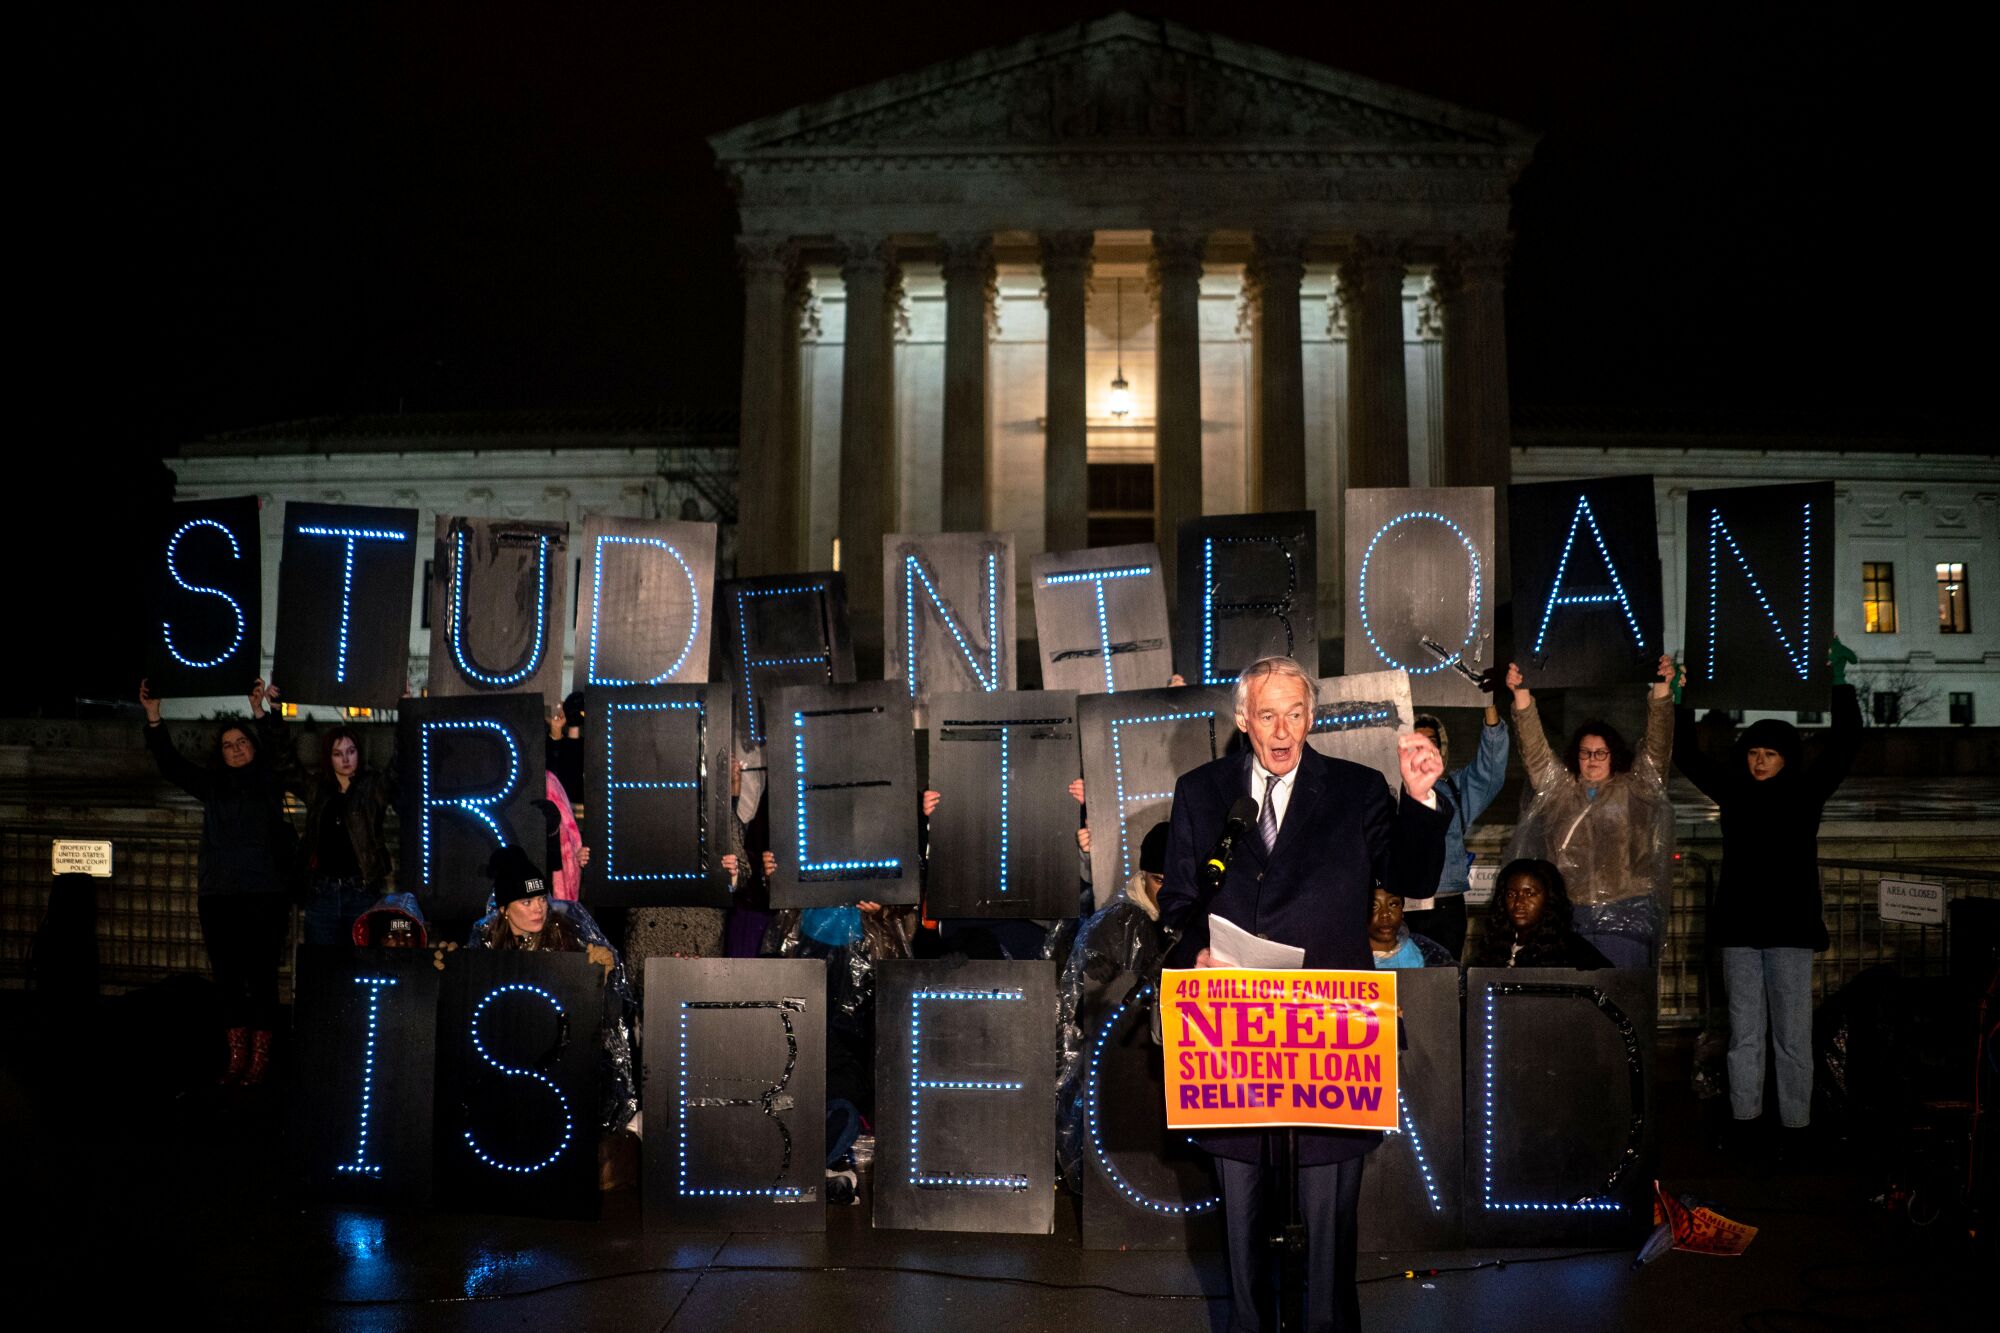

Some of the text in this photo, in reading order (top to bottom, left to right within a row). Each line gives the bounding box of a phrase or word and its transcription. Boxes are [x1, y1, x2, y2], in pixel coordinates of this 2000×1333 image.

[527, 880, 544, 890] RISE
[1886, 886, 1938, 899] AREA CLOSED
[392, 920, 409, 929] RISE
[1175, 979, 1380, 1000] 40 MILLION FAMILIES
[1175, 1001, 1381, 1050] NEED
[337, 977, 571, 1172] IS
[1179, 1051, 1381, 1082] STUDENT LOAN
[1179, 1083, 1383, 1111] RELIEF NOW
